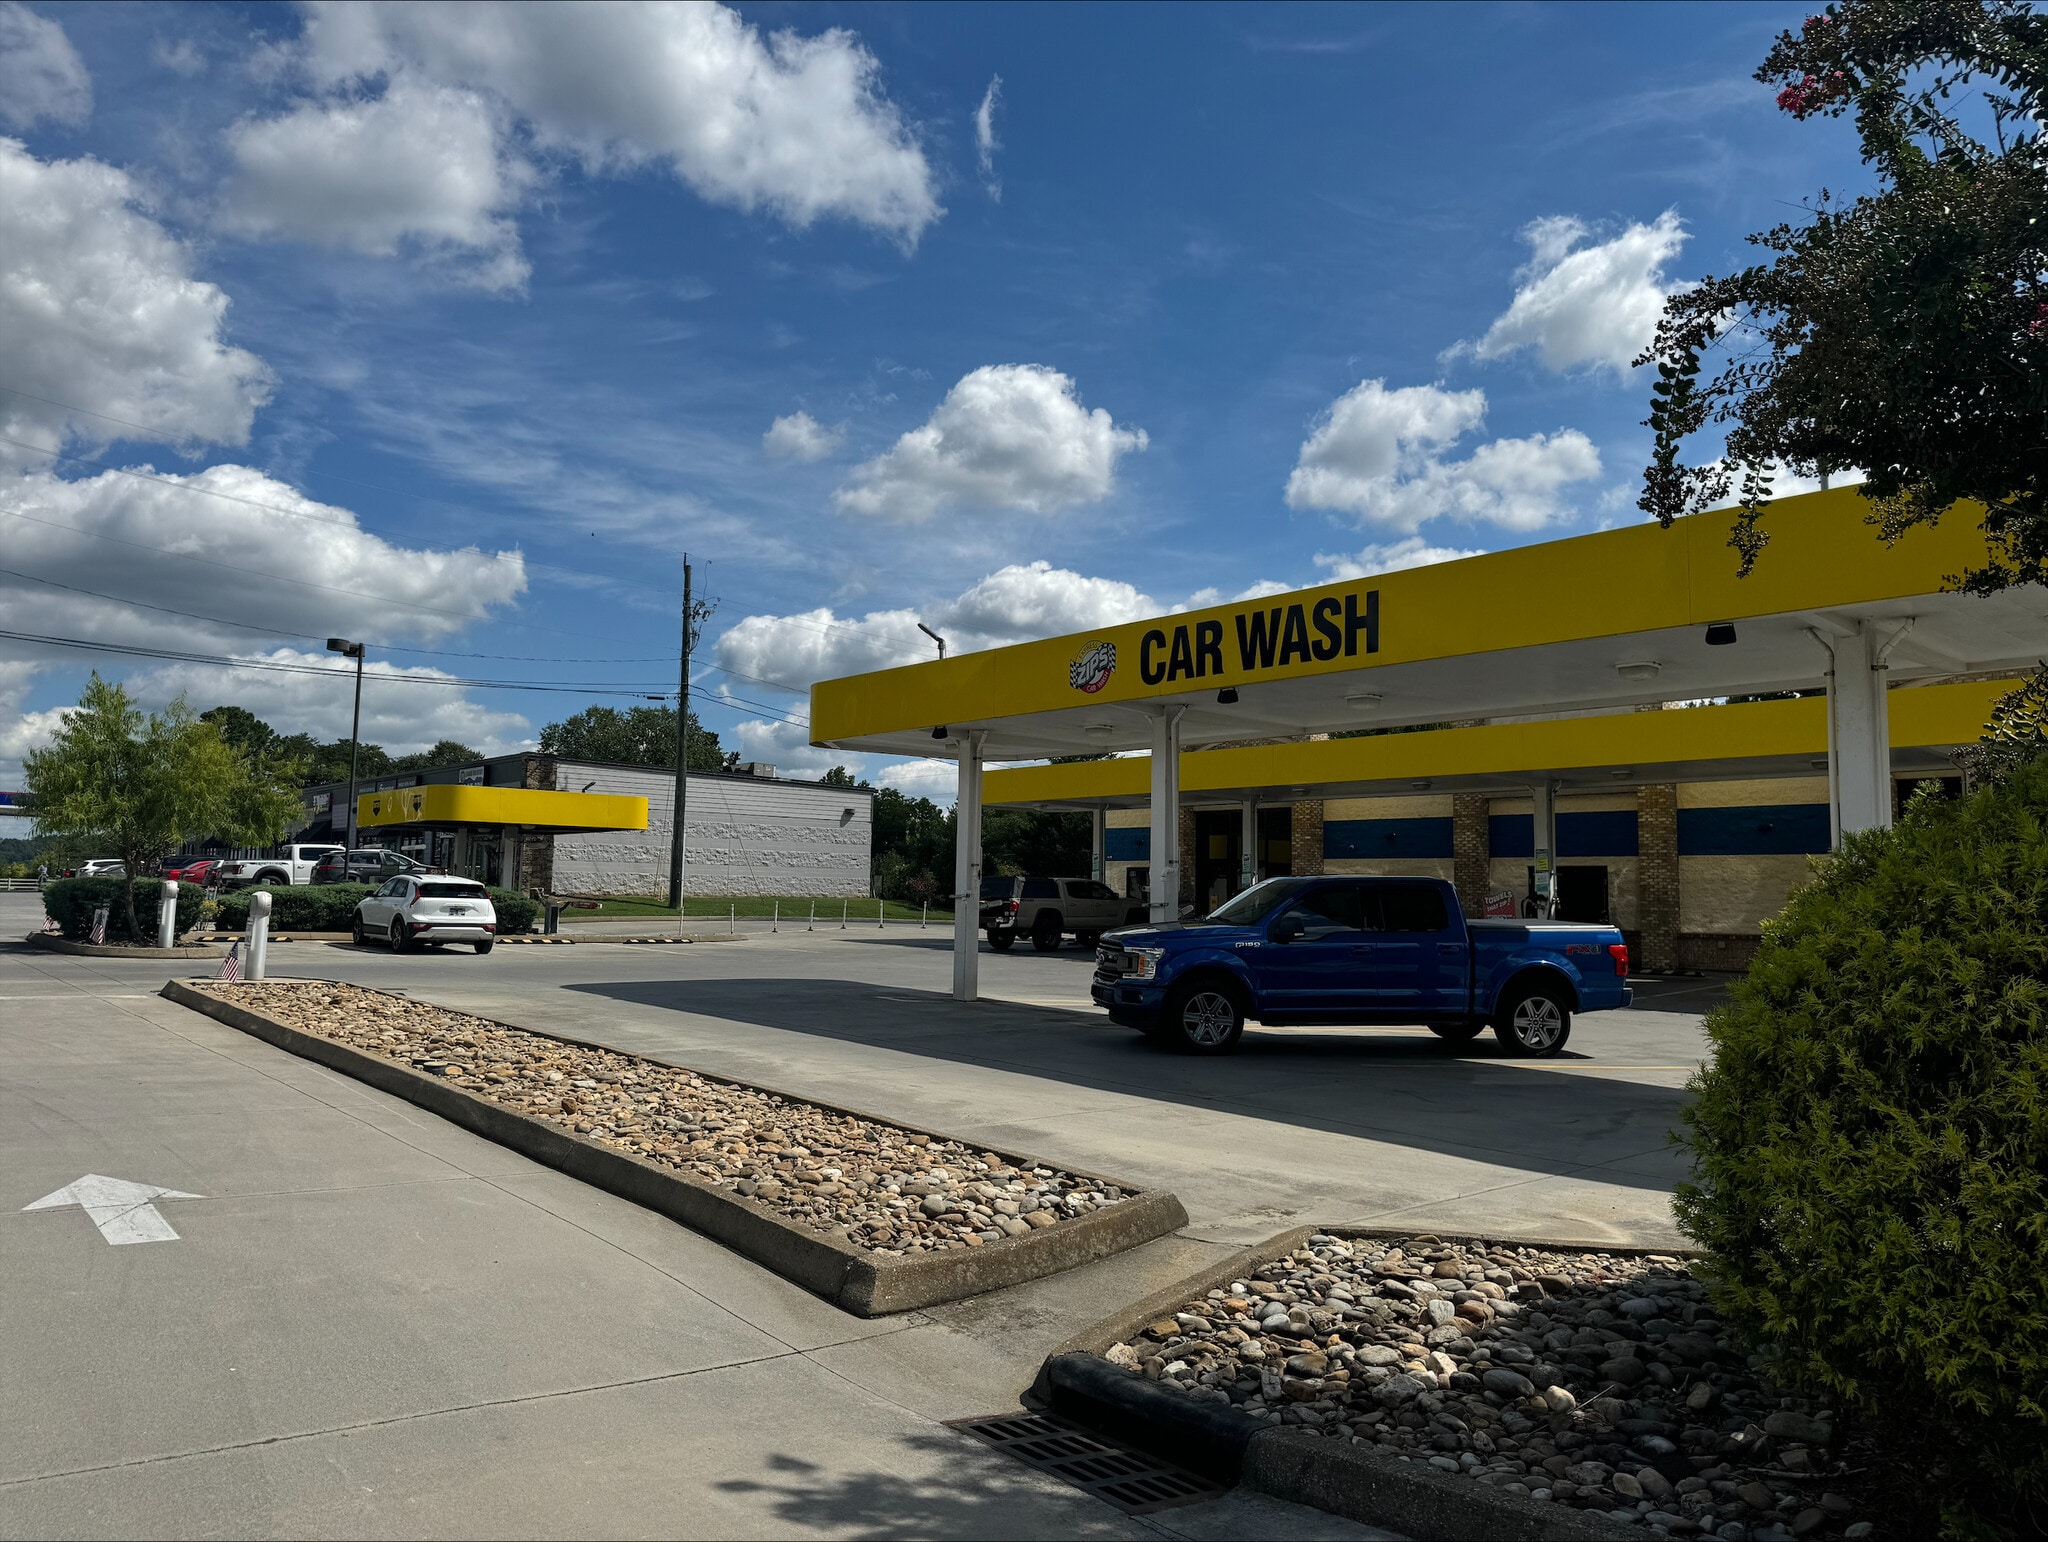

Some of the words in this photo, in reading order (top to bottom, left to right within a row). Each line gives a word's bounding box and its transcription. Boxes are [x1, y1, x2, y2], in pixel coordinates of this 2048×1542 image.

[1140, 620, 1224, 686] CAR
[1235, 590, 1379, 671] WASH
[1077, 647, 1109, 685] ZIPS
[1086, 683, 1098, 692] CAR
[1097, 671, 1109, 688] WASH
[1484, 891, 1513, 904] TOWELS
